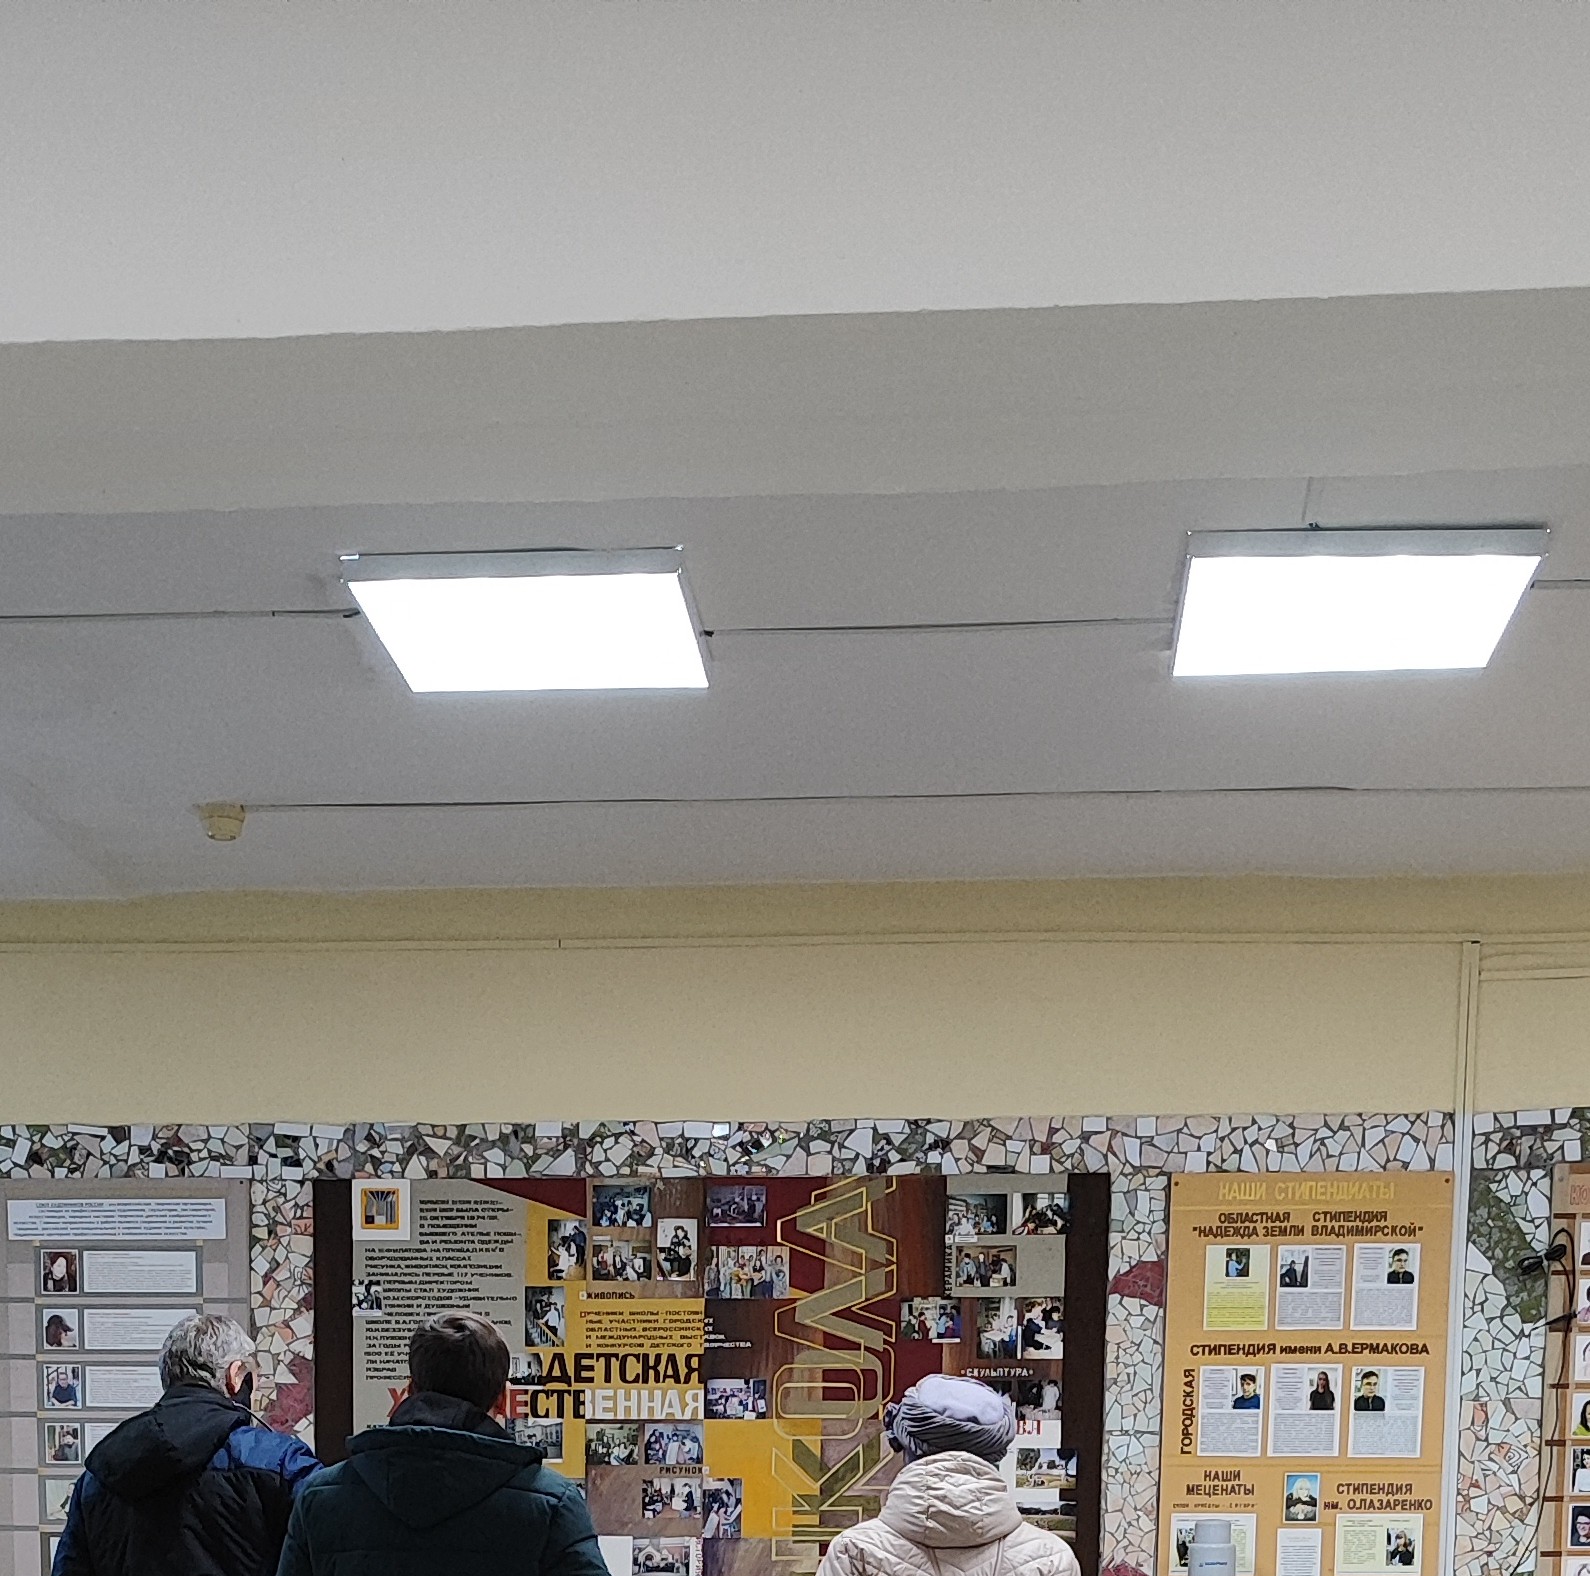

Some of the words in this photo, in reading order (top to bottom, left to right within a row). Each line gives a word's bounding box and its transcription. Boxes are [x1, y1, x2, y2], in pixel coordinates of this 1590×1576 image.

[1218, 1181, 1266, 1201] НАШИ
[1275, 1181, 1395, 1201] СТИПЕНДИАТЫ
[1218, 1211, 1291, 1224] ОБЛАСТНАЯ
[1312, 1210, 1388, 1224] СТИПЕНДИЯ
[1192, 1225, 1259, 1239] "НАДЕЖДА
[1262, 1225, 1305, 1238] ЗЕМЛИ
[1311, 1222, 1424, 1239] ВЛАДИМИРСКОЙ"
[586, 1292, 636, 1300] ЖИВОПИСЬ
[1190, 1343, 1276, 1357] СТИПЕНДИЯ
[1279, 1345, 1322, 1355] имени
[1324, 1342, 1430, 1355] А.В.ЕРМАКОВА
[542, 1352, 704, 1387] ДЕТСКАЯ
[966, 1367, 1029, 1377] СКУЛЬПТУРА
[387, 1388, 704, 1420] ХЕСТВЕННАЯ
[1180, 1369, 1196, 1455] ГОРОДСКАЯ
[659, 1466, 703, 1475] РИСУНОК
[1203, 1470, 1241, 1482] НАШИ
[1186, 1484, 1255, 1498] МЕЦЕНАТЫ
[1336, 1482, 1413, 1497] СТИПЕНДИЯ
[1347, 1498, 1433, 1511] О.ЛАЗАРЕНКО
